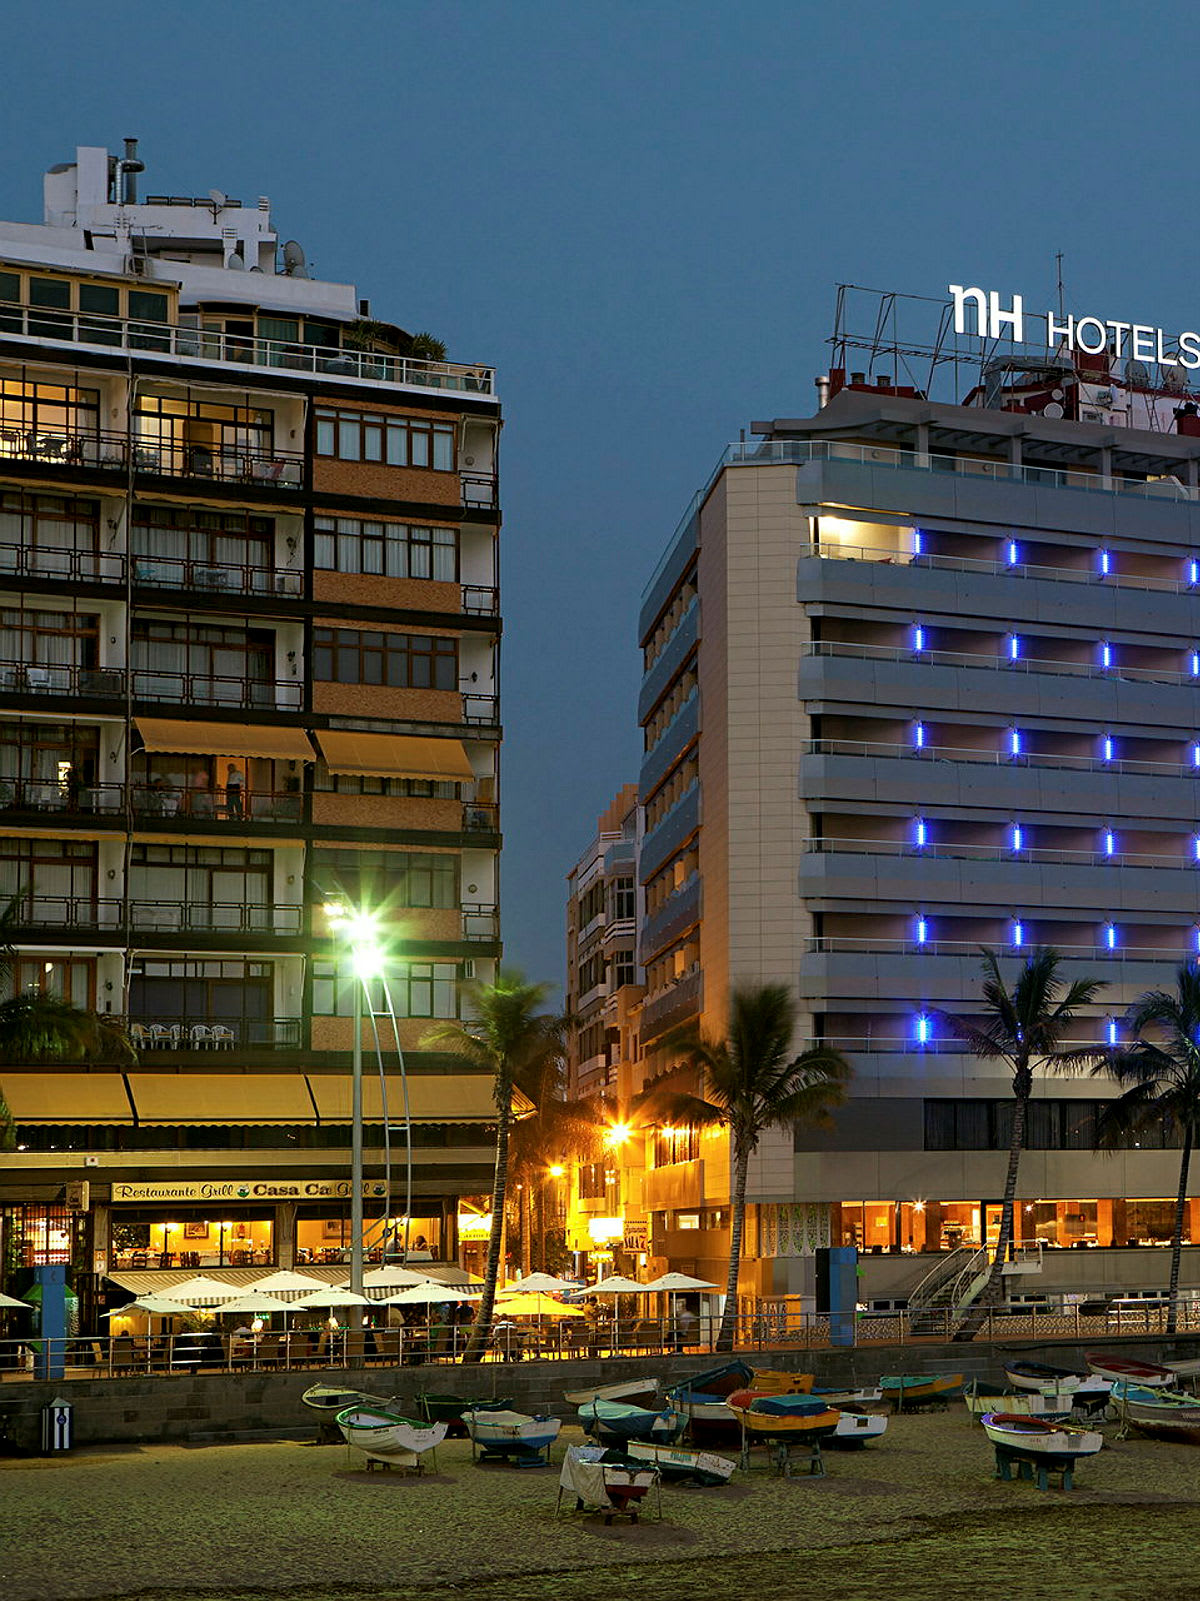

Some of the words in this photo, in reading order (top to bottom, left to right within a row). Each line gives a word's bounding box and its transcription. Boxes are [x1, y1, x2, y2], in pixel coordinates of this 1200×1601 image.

[115, 1184, 197, 1198] Restaurante
[201, 1183, 233, 1198] Grill
[253, 1183, 300, 1196] Casa
